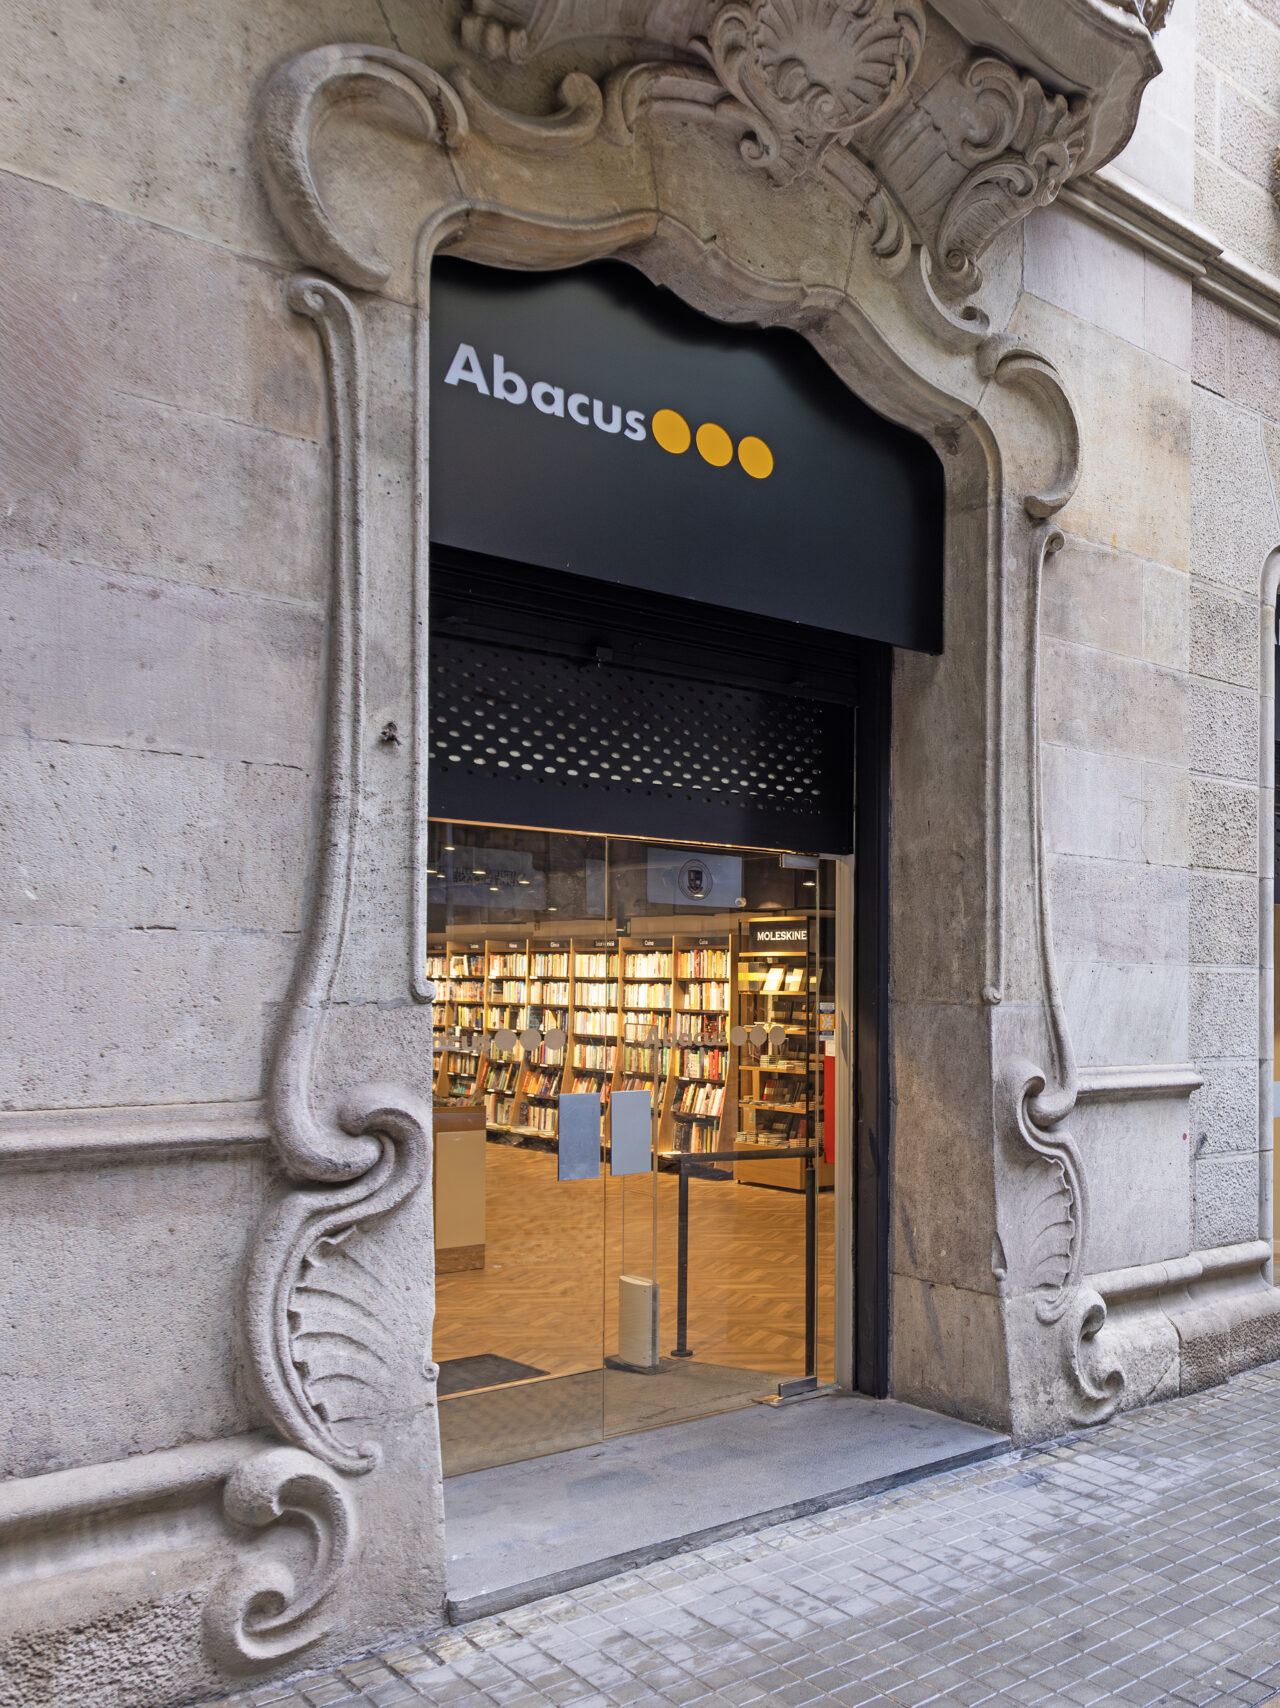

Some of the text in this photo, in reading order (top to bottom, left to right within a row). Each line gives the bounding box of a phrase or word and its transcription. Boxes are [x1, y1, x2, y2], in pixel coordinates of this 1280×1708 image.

[443, 341, 648, 443] Abacus
[756, 930, 808, 942] MOLESKINE
[643, 1026, 728, 1048] Abacus
